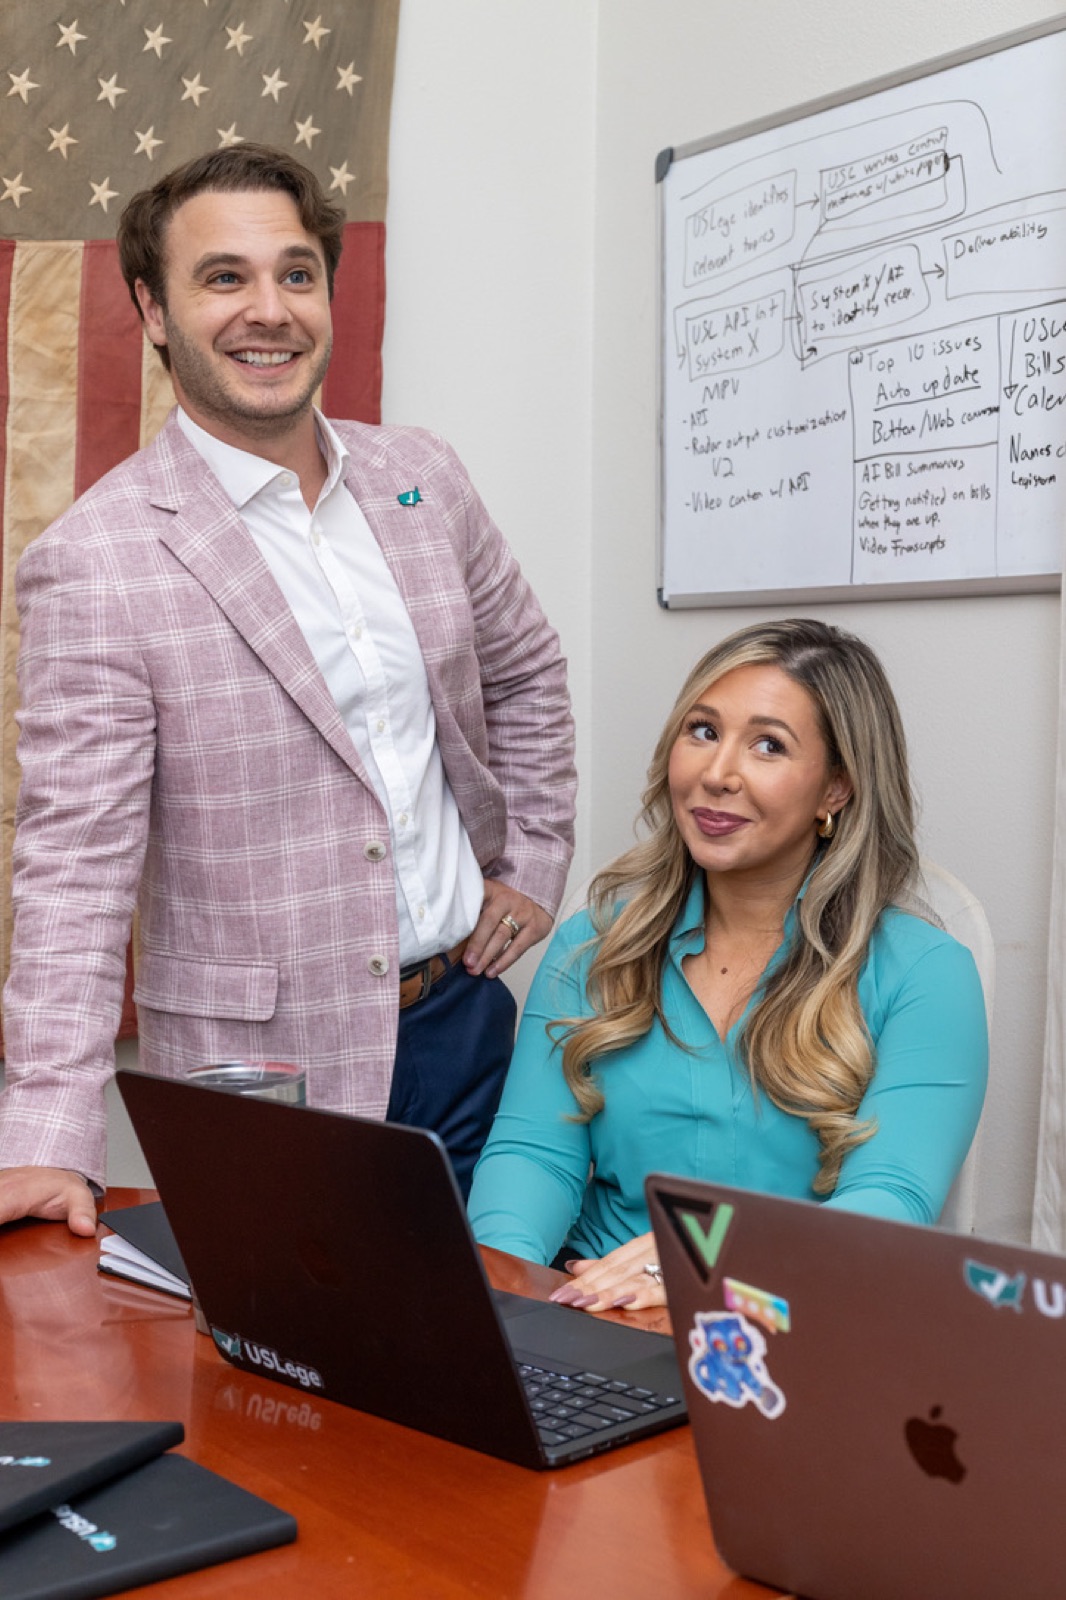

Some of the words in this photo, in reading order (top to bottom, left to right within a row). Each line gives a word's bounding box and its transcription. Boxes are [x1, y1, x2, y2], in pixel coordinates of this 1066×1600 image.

[722, 306, 751, 337] API
[866, 349, 895, 374] Top
[908, 343, 925, 363] 10
[932, 335, 983, 357] issues
[702, 377, 740, 404] MPV
[876, 381, 911, 406] Auto
[1009, 433, 1052, 464] Names
[712, 456, 735, 478] V2
[862, 462, 882, 484] AI
[952, 491, 966, 501] on
[244, 1341, 322, 1388] USLege
